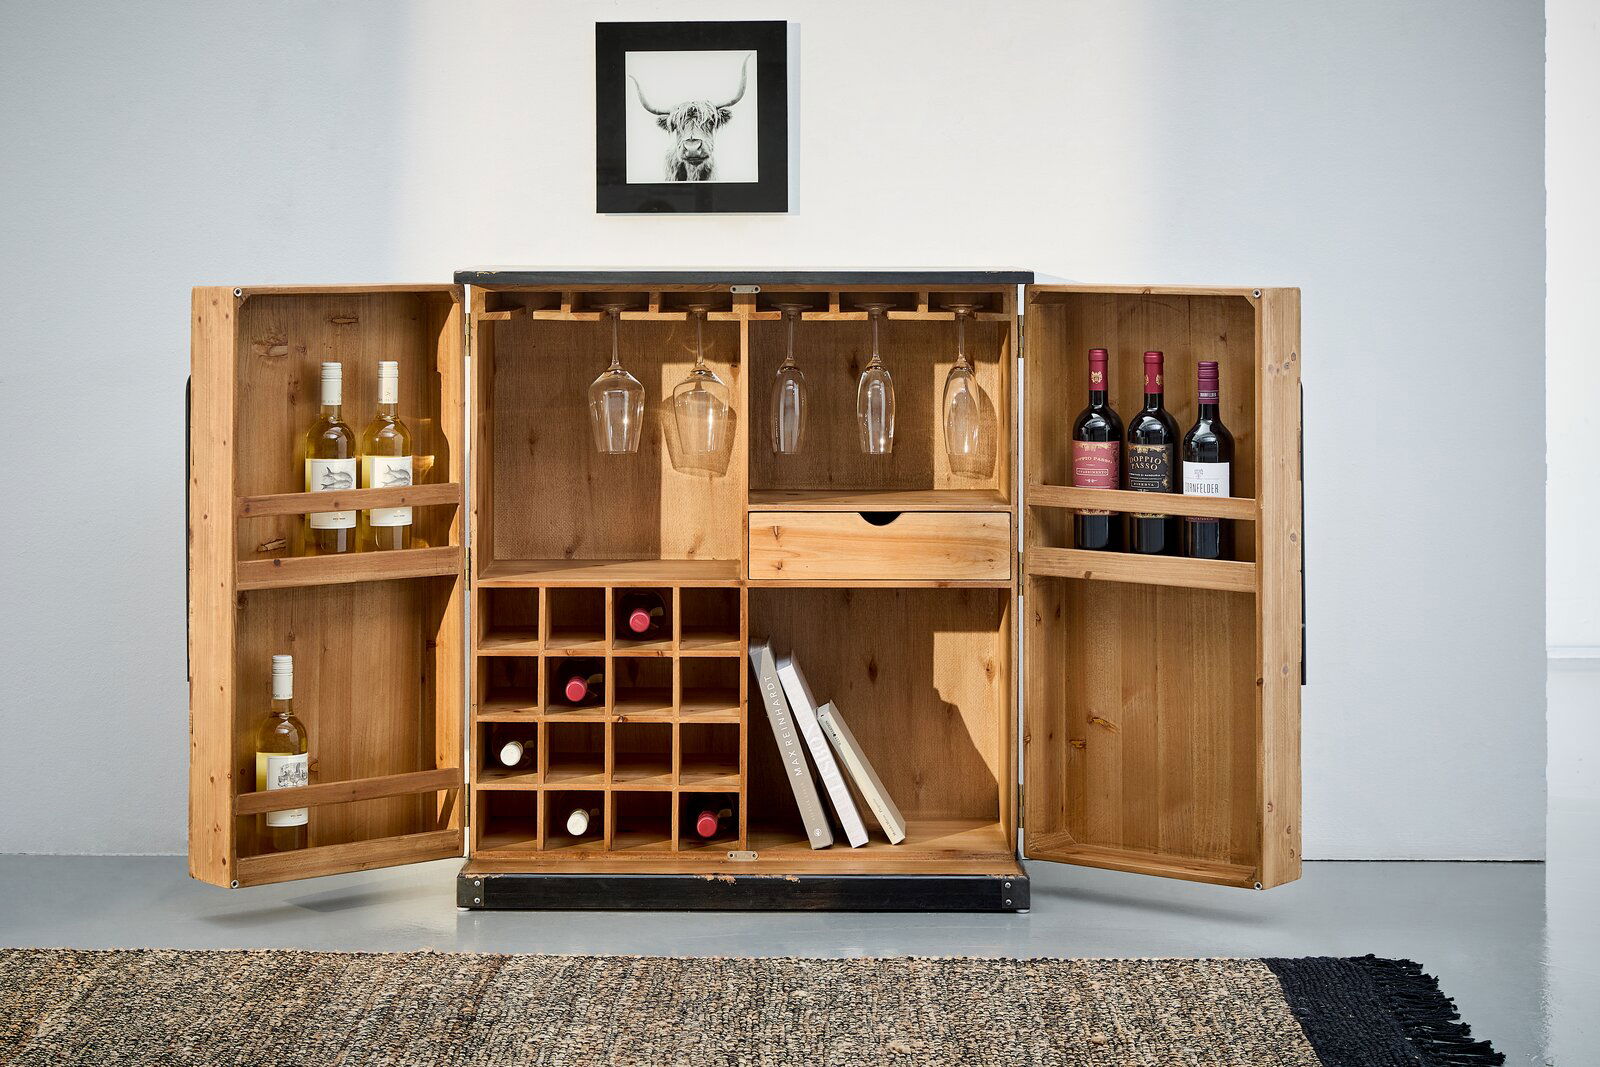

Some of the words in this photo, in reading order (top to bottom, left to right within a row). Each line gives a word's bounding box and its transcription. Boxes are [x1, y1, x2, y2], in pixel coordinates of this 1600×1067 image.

[1129, 455, 1162, 465] DOPPIO
[1131, 463, 1158, 471] PASSO
[763, 676, 794, 747] REINHARDT
[788, 750, 803, 777] MAX
